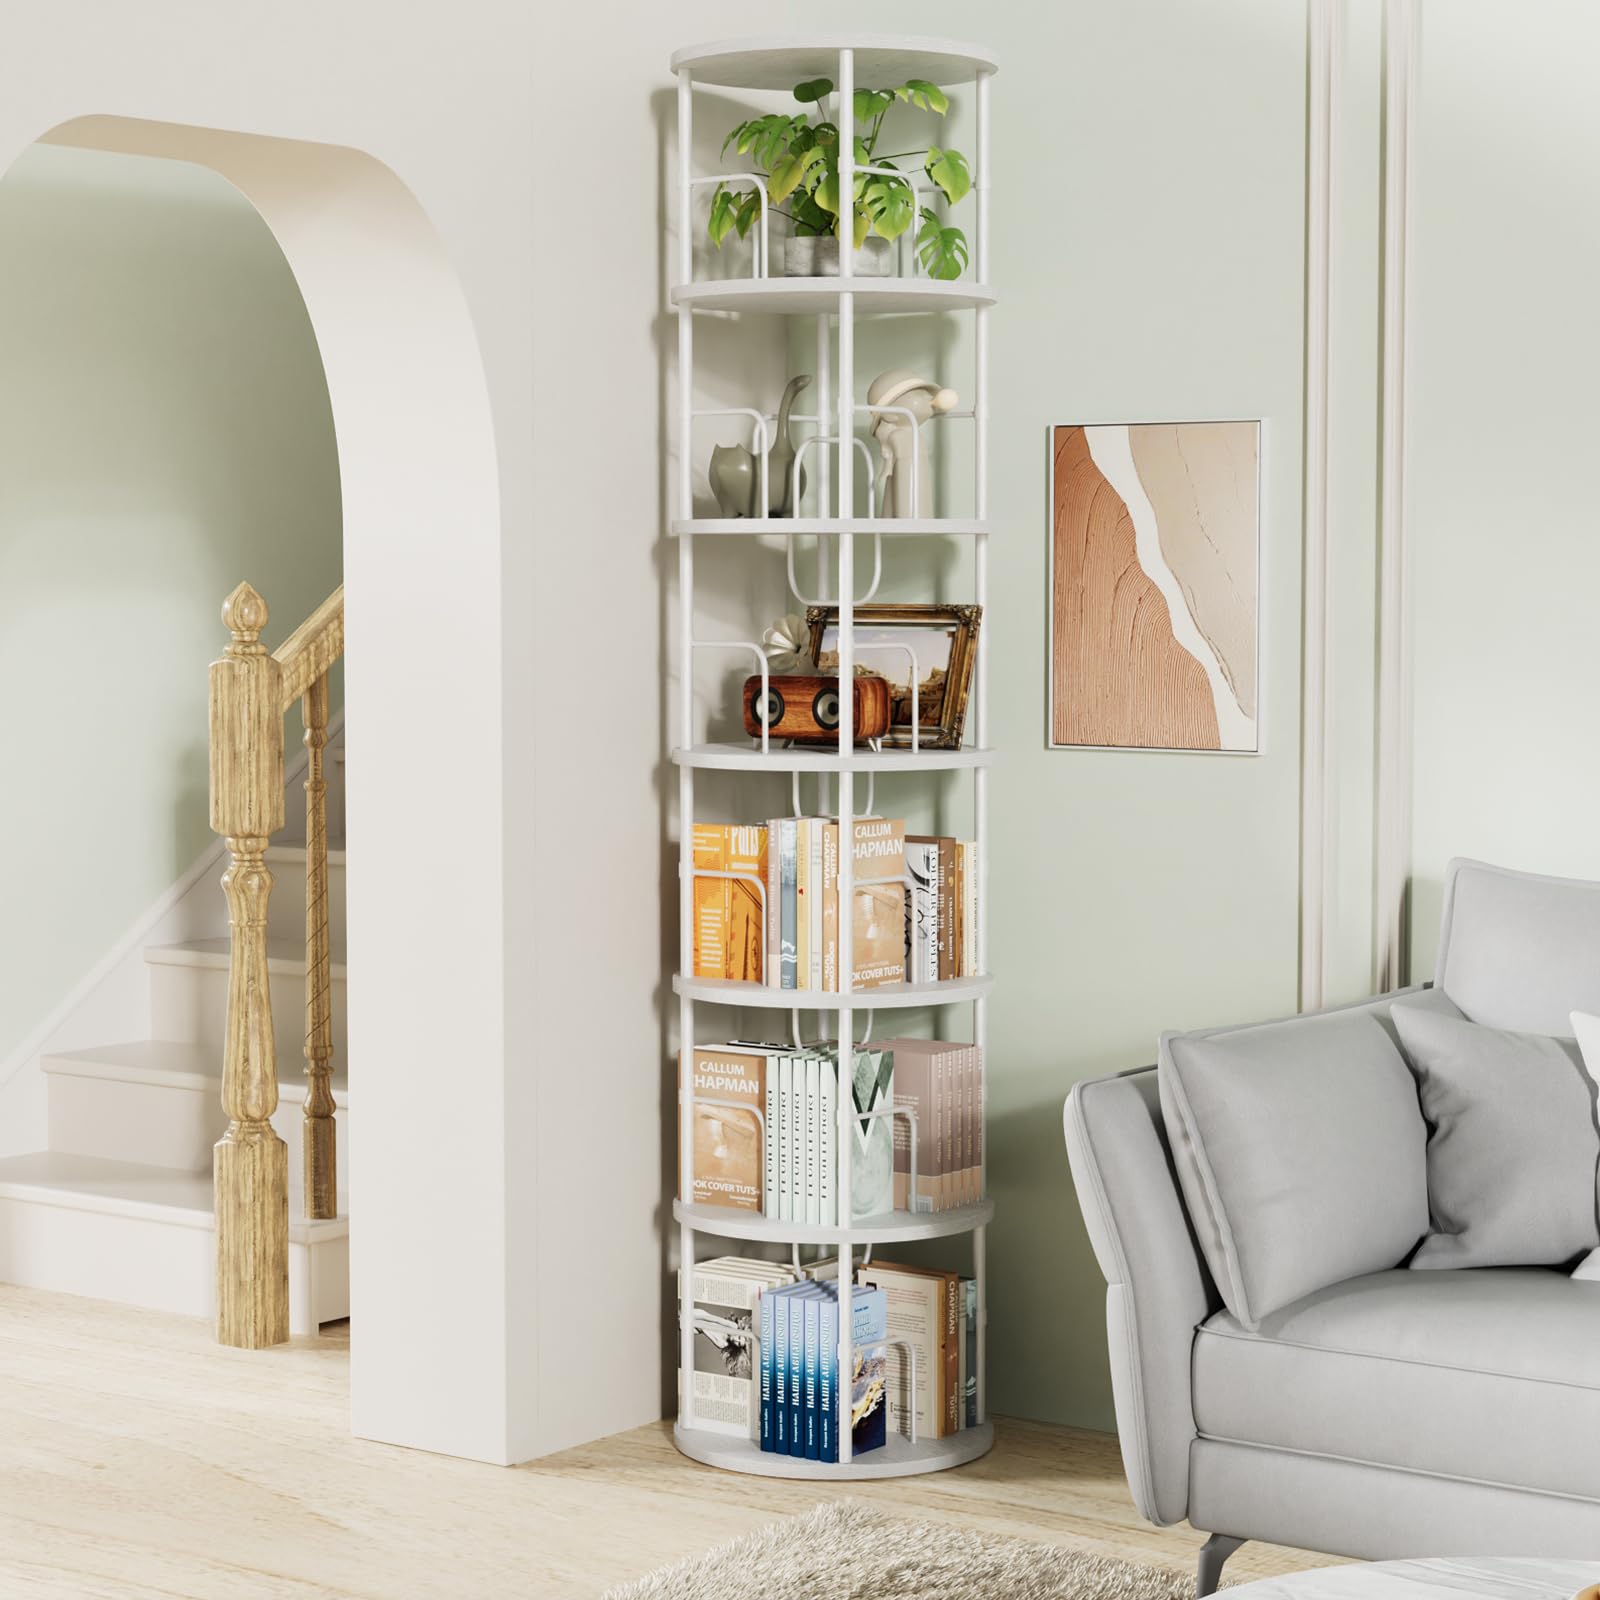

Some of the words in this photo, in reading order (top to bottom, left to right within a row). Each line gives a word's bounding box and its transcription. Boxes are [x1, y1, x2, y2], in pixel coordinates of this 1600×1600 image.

[855, 823, 892, 839] CALLUM
[852, 839, 903, 859] HAPMAN
[861, 967, 883, 980] COVER
[699, 1060, 745, 1076] CALLUM
[693, 1074, 759, 1095] HAPMAN
[707, 1181, 735, 1193] COVER
